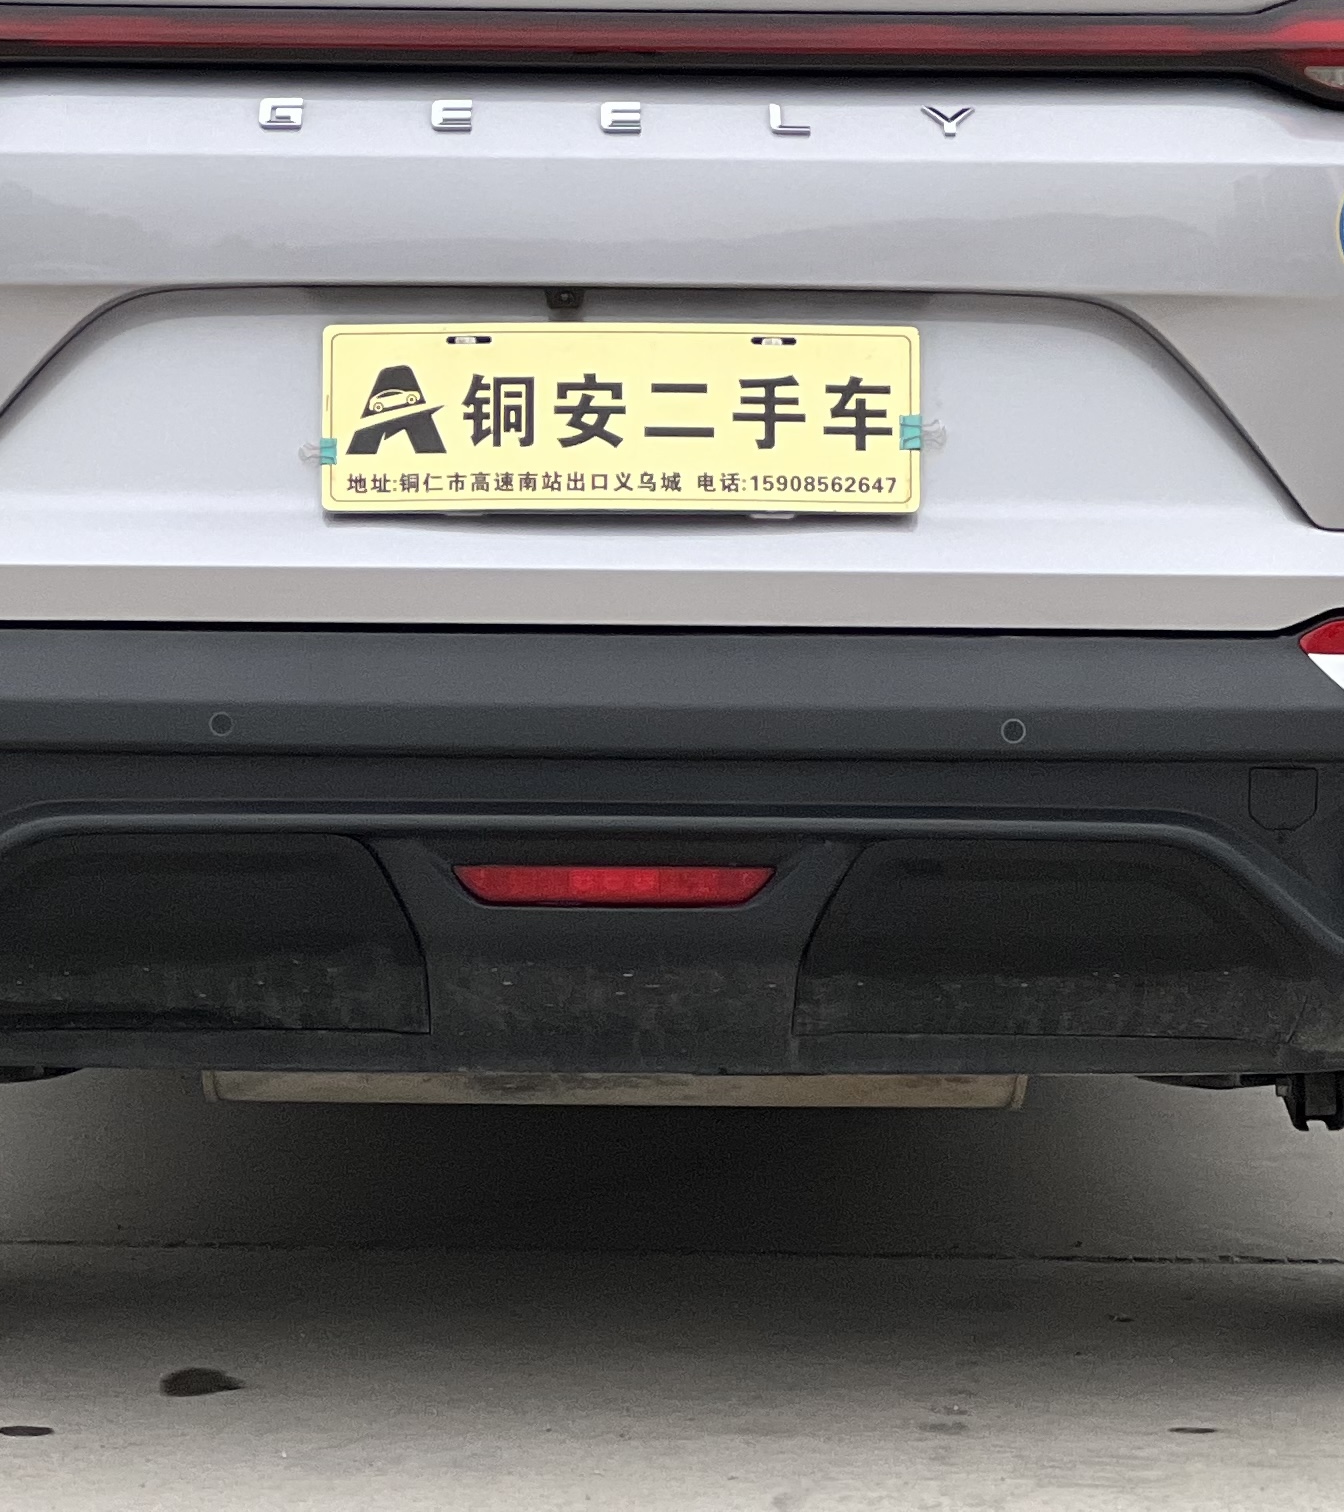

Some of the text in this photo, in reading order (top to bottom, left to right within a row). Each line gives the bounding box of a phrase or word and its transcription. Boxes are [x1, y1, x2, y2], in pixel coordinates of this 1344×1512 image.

[258, 97, 976, 137] GEELY
[462, 373, 894, 451] 铜安二手车
[346, 471, 898, 495] 地址:铜仁市高速南站出口义乌城 电话:15908562647
